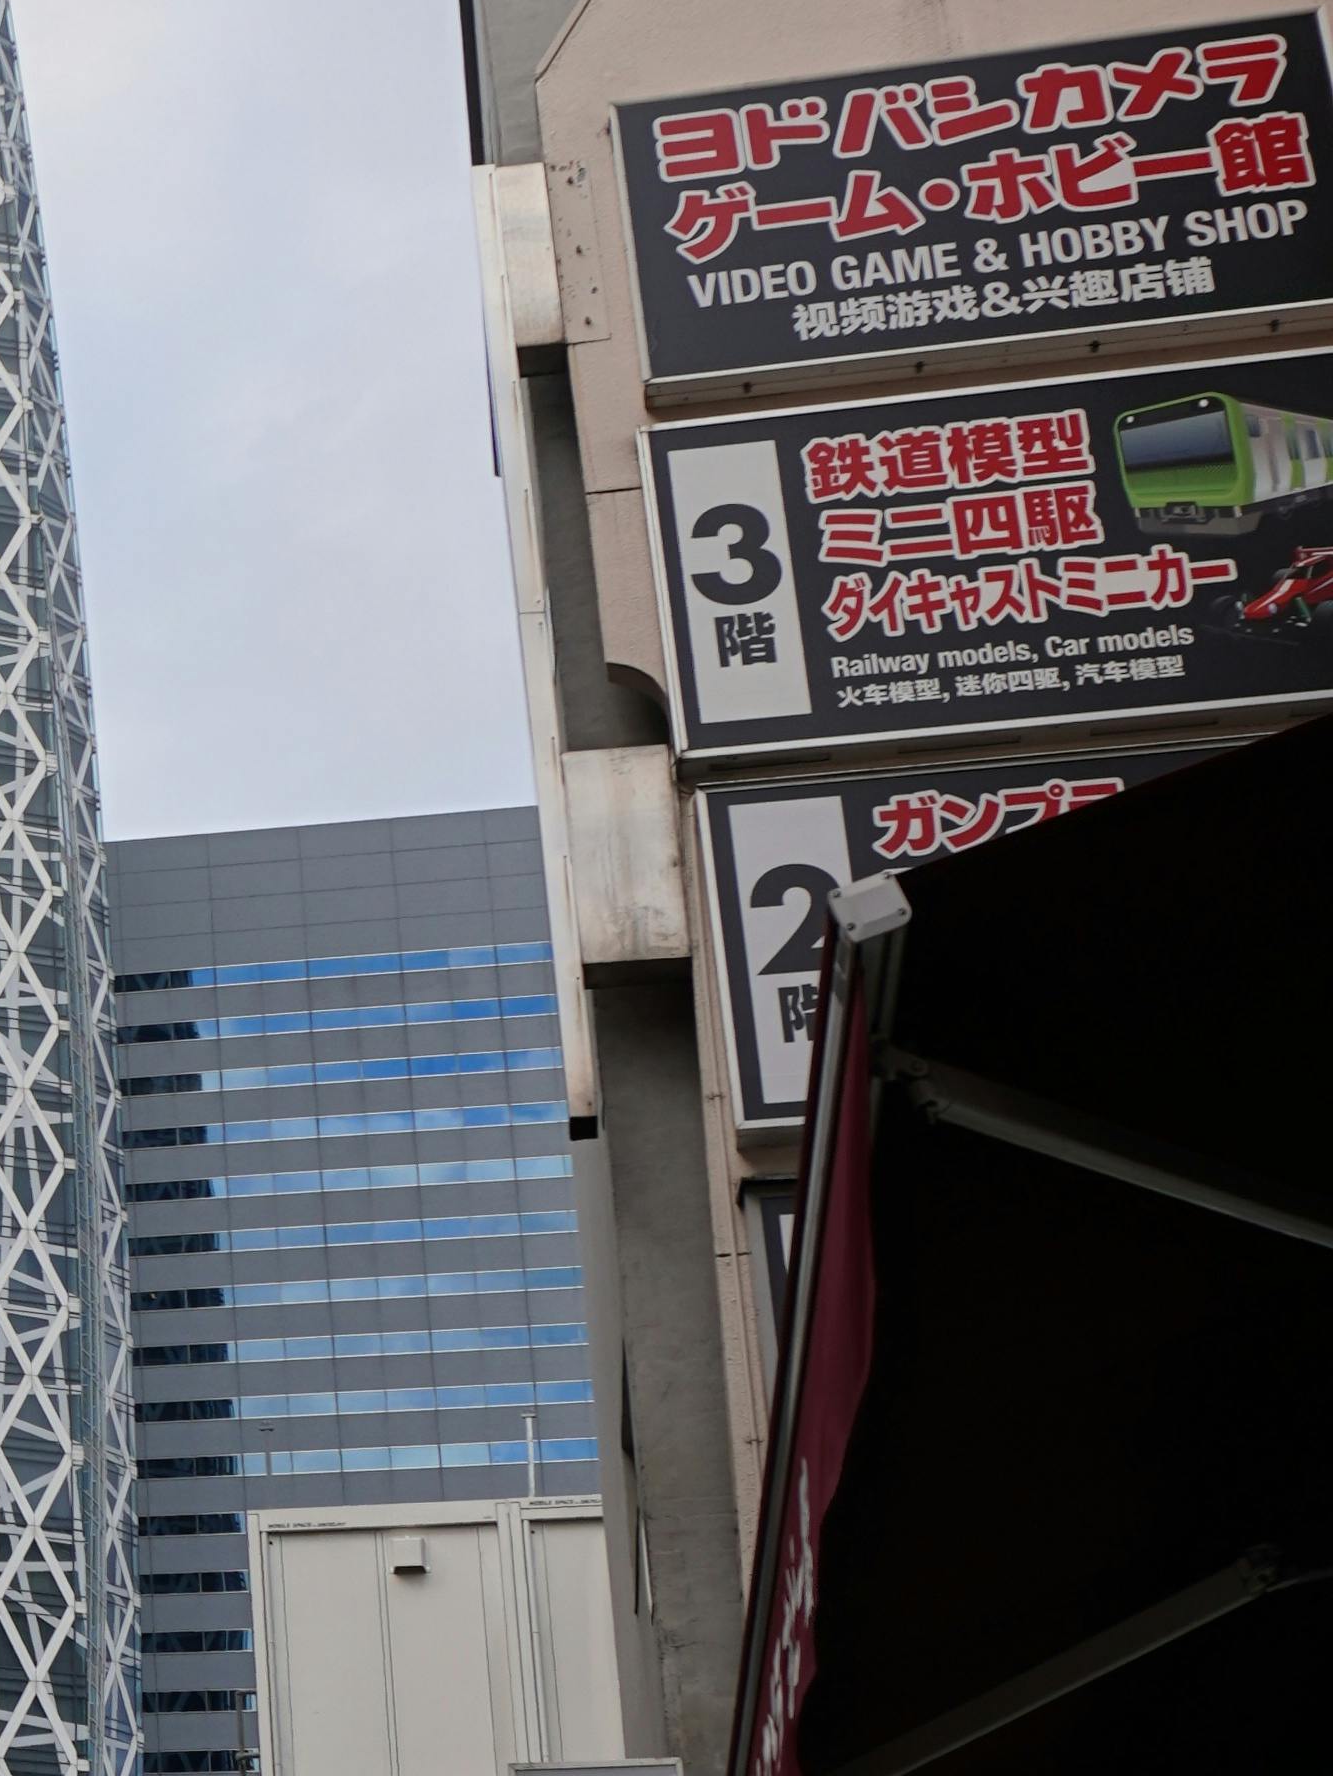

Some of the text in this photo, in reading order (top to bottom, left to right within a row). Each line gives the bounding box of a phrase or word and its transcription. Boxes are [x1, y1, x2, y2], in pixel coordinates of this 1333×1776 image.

[652, 35, 1287, 181] ヨドバシカメラ
[665, 111, 1316, 265] ゲーム・ホビー館
[687, 200, 1309, 310] VIDEO GAME & HOBBY SHOP
[792, 257, 1214, 340] 视频游戏&兴趣店铺
[802, 408, 1094, 504] 鉄道模型
[814, 482, 1103, 568] ミニ四駆
[824, 543, 1236, 638] ダイキャストミニカー
[830, 624, 1194, 681] Railway models, Car models
